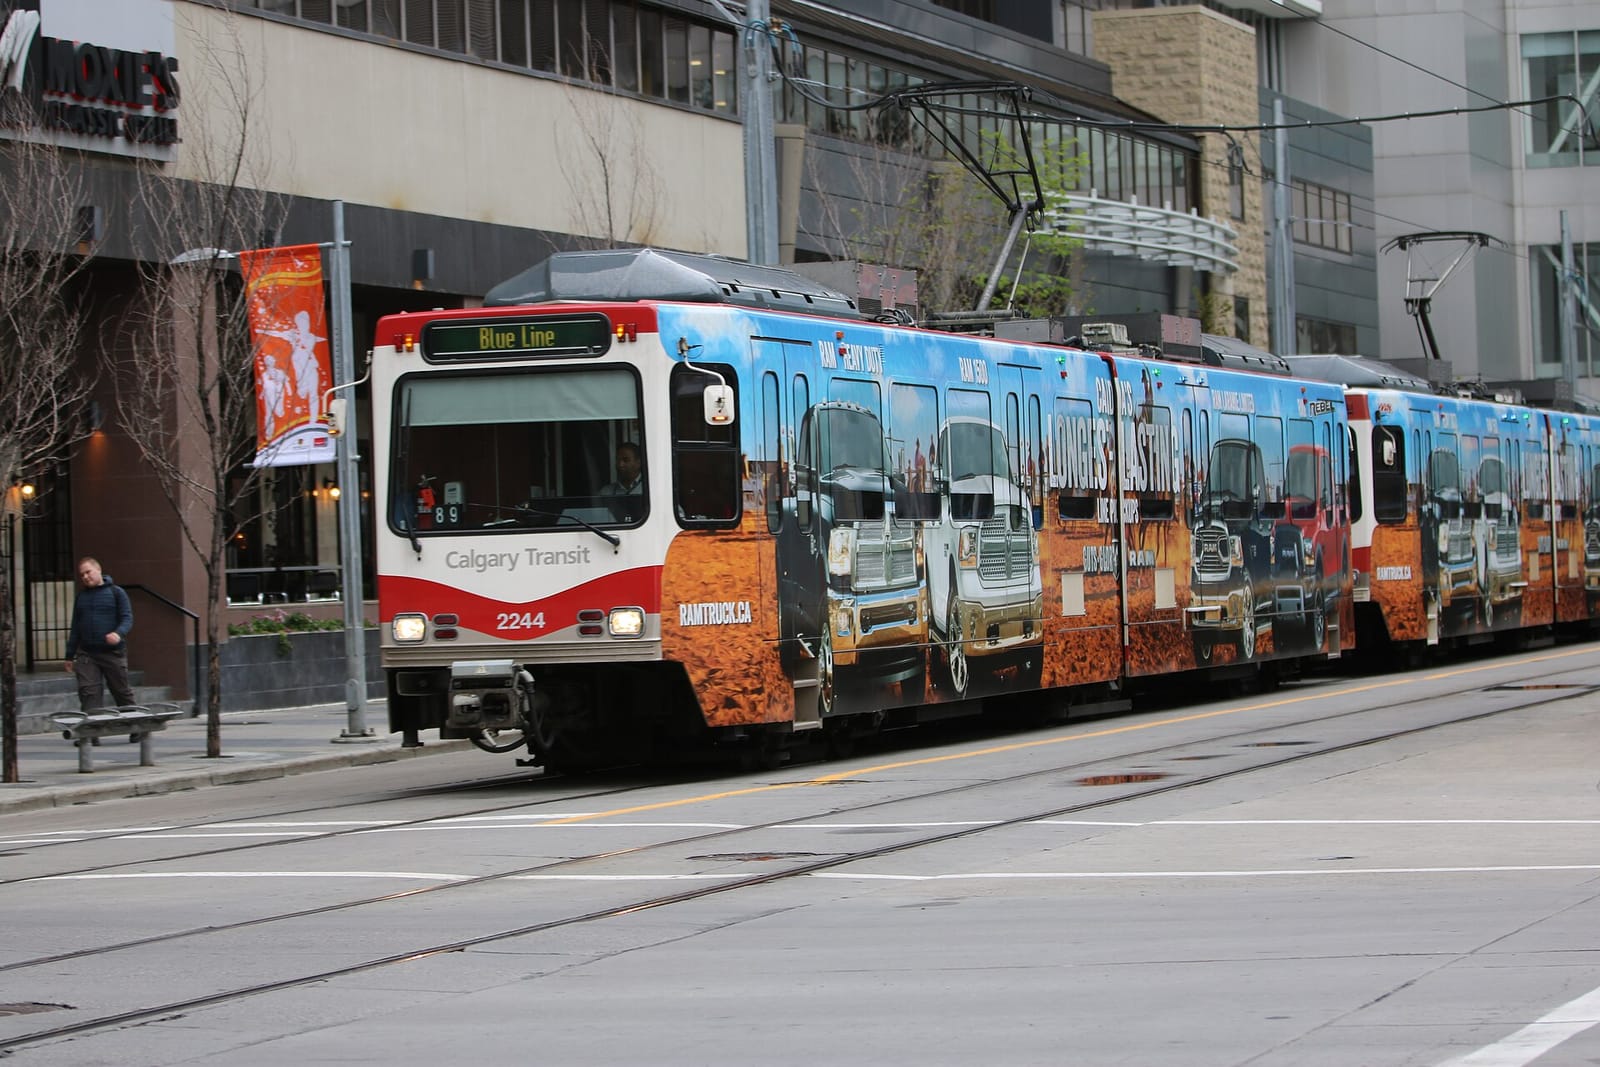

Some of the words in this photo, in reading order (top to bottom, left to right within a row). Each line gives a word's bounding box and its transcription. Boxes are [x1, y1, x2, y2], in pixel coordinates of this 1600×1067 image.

[479, 327, 516, 349] Blue
[521, 325, 556, 347] Line
[818, 340, 837, 368] RAM
[958, 357, 974, 382] RAM
[1309, 400, 1336, 417] REBEL
[1048, 414, 1110, 490] LONGES
[1121, 422, 1181, 493] LASTING
[445, 549, 520, 573] Calgary
[525, 545, 590, 567] Transit
[1129, 549, 1155, 566] RAM
[497, 612, 546, 630] 2244
[679, 601, 752, 626] RAMTRUCK.CA
